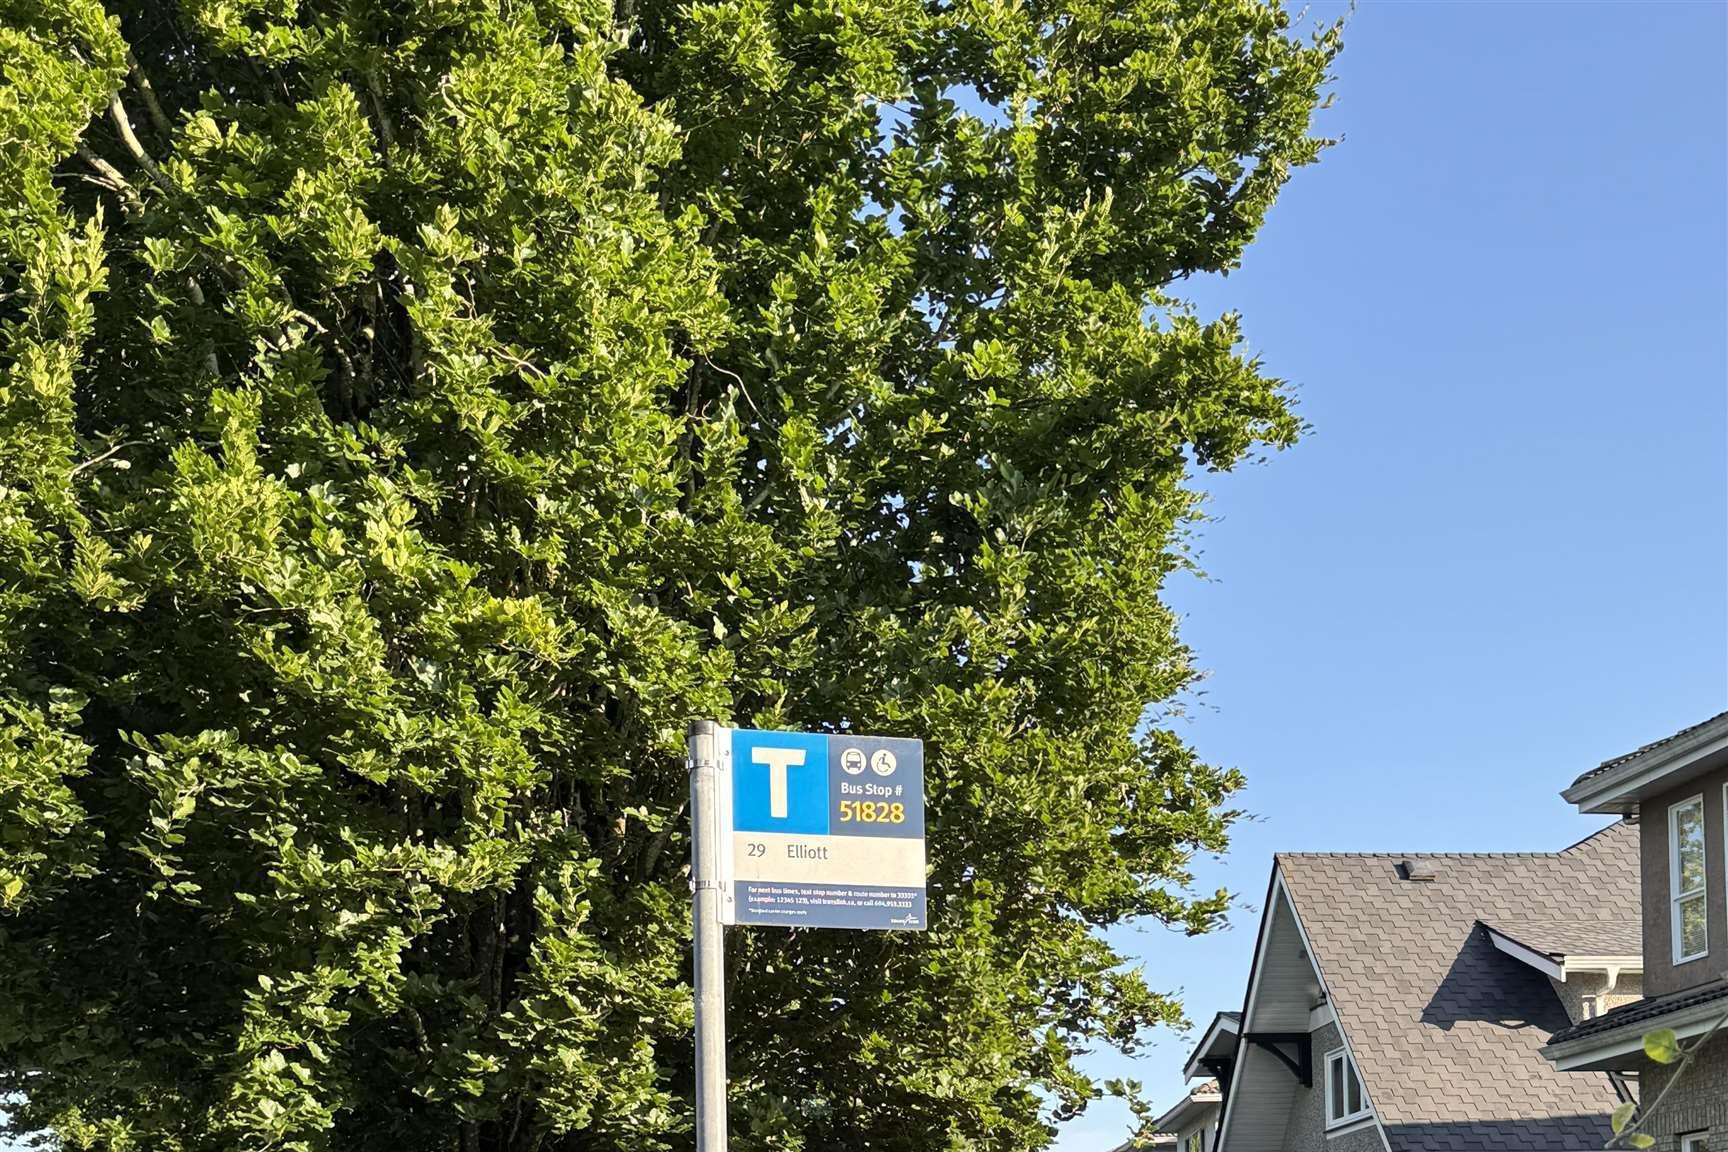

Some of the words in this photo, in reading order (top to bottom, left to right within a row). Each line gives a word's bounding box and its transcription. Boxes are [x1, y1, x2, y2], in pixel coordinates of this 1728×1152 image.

[751, 746, 807, 818] T
[840, 782, 863, 795] Bus
[865, 784, 892, 798] Stop
[894, 785, 903, 797] #
[839, 800, 905, 824] 51828
[747, 843, 766, 858] 29
[787, 844, 828, 860] Elliott
